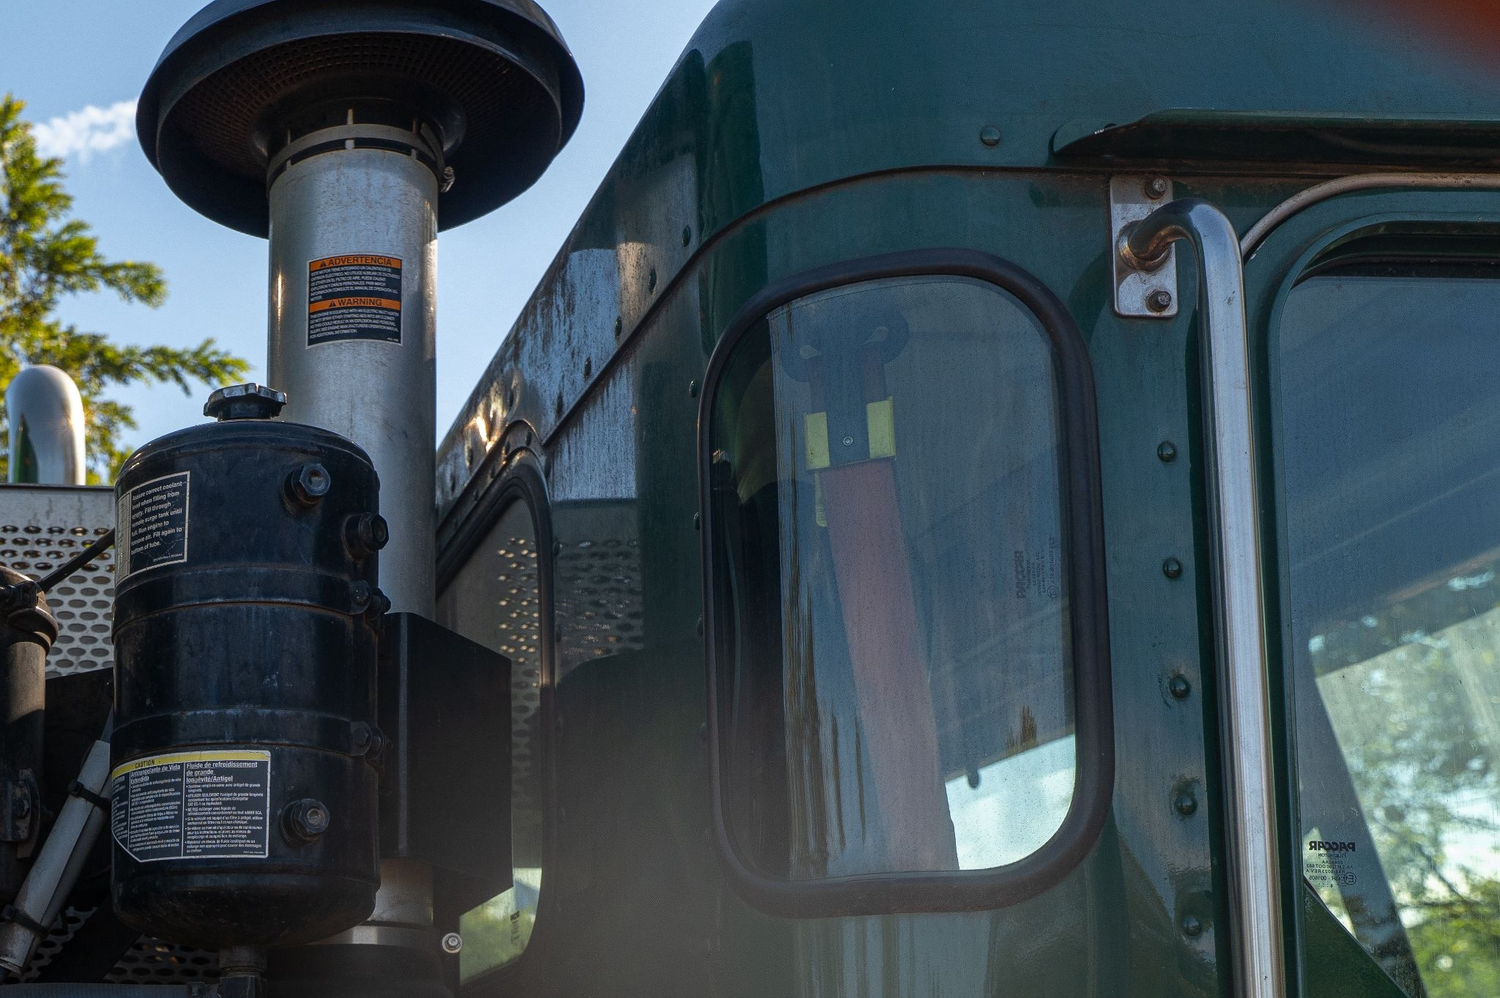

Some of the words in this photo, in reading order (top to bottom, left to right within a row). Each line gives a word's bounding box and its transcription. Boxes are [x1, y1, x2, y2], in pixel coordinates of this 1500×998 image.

[328, 257, 392, 266] ADVERTENCIA
[146, 486, 162, 495] correct
[163, 482, 182, 490] coolant
[152, 502, 171, 511] through
[148, 522, 163, 531] engine
[161, 529, 175, 537] again
